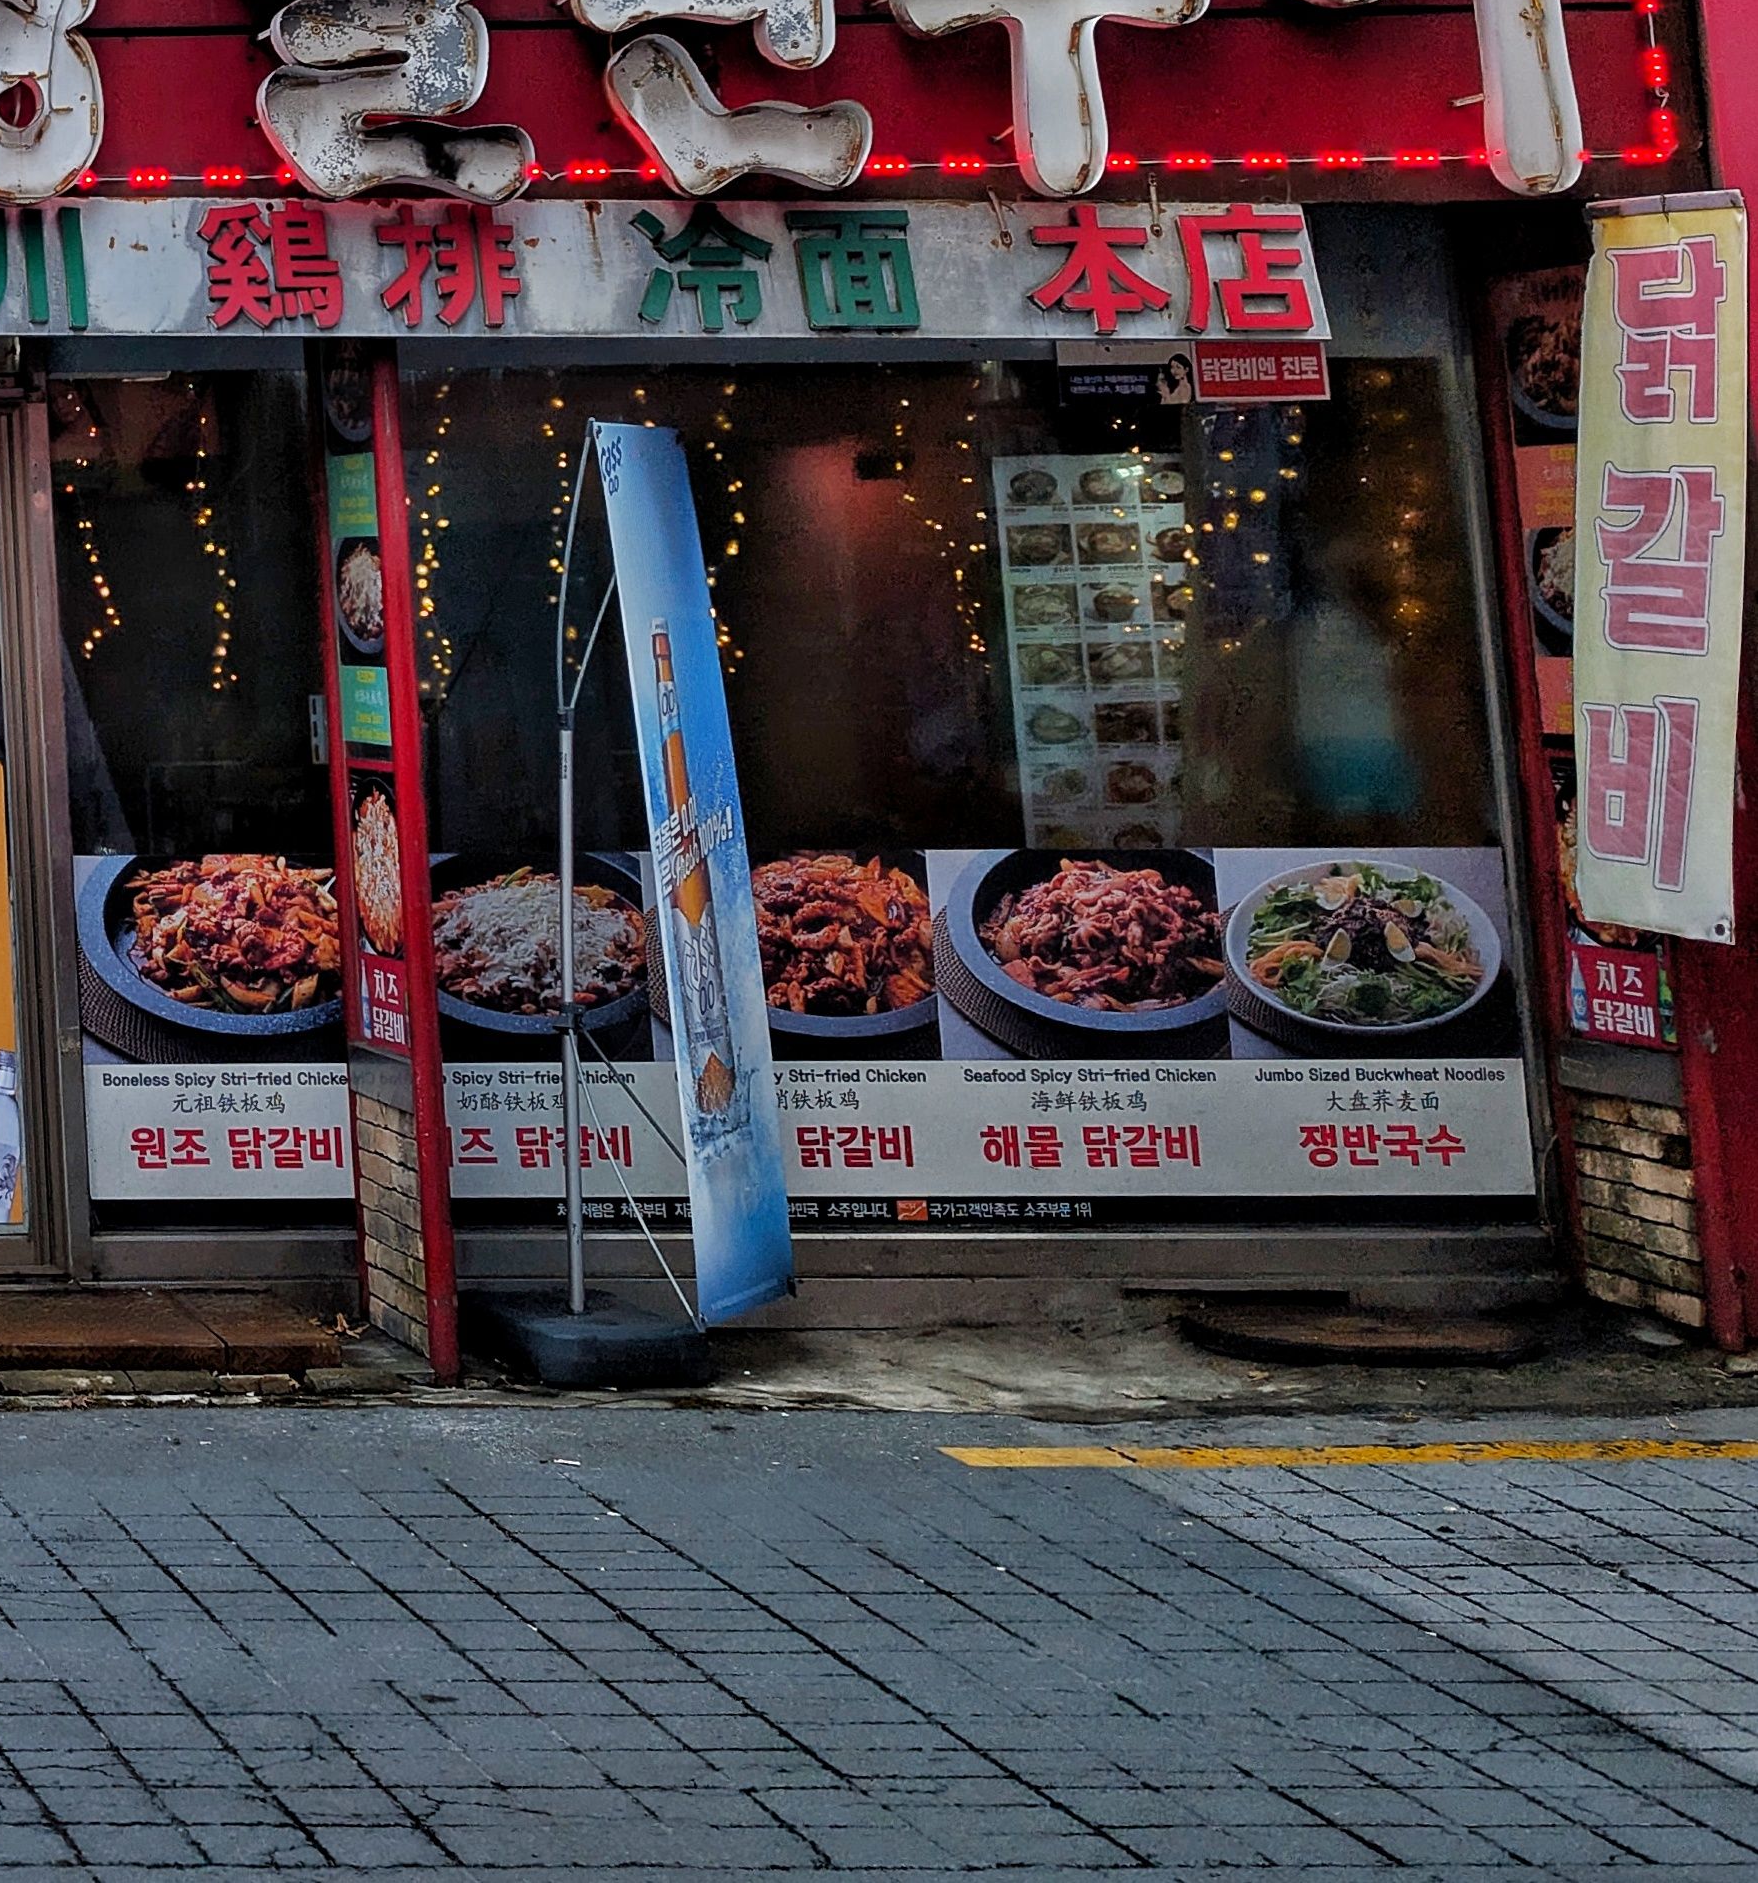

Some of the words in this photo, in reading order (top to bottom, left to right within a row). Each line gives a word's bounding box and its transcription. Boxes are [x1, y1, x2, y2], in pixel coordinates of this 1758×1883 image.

[1201, 356, 1276, 382] 닭갈비엔
[1282, 355, 1321, 381] 진로
[1581, 234, 1728, 894] 닭갈비
[1594, 959, 1645, 998] 치즈
[1591, 997, 1656, 1039] 닭갈비
[103, 1071, 171, 1088] Boneless
[174, 1071, 217, 1091] Spicy
[220, 1071, 293, 1088] Stri-fried
[452, 1069, 494, 1088] Spicy
[788, 1068, 863, 1085] Stri-fried
[865, 1068, 927, 1085] Chicken
[963, 1067, 1028, 1084] Seafood
[1031, 1067, 1073, 1086] Spicy
[1076, 1066, 1152, 1083] Stri-fried
[1155, 1066, 1217, 1083] Chicken
[1254, 1067, 1304, 1084] Jumbo
[1307, 1066, 1352, 1083] Sized
[1355, 1066, 1440, 1083] Buckwheat
[1444, 1066, 1506, 1083] Noodles
[129, 1125, 212, 1171] 원조
[226, 1125, 347, 1171] 닭갈비
[795, 1124, 915, 1169] 닭갈비
[980, 1123, 1064, 1170] 해물
[1083, 1123, 1202, 1169] 닭갈비
[1298, 1123, 1467, 1169] 쟁반국수
[929, 1201, 1021, 1219] 국가고객만족도
[1024, 1201, 1072, 1219] 소주부문
